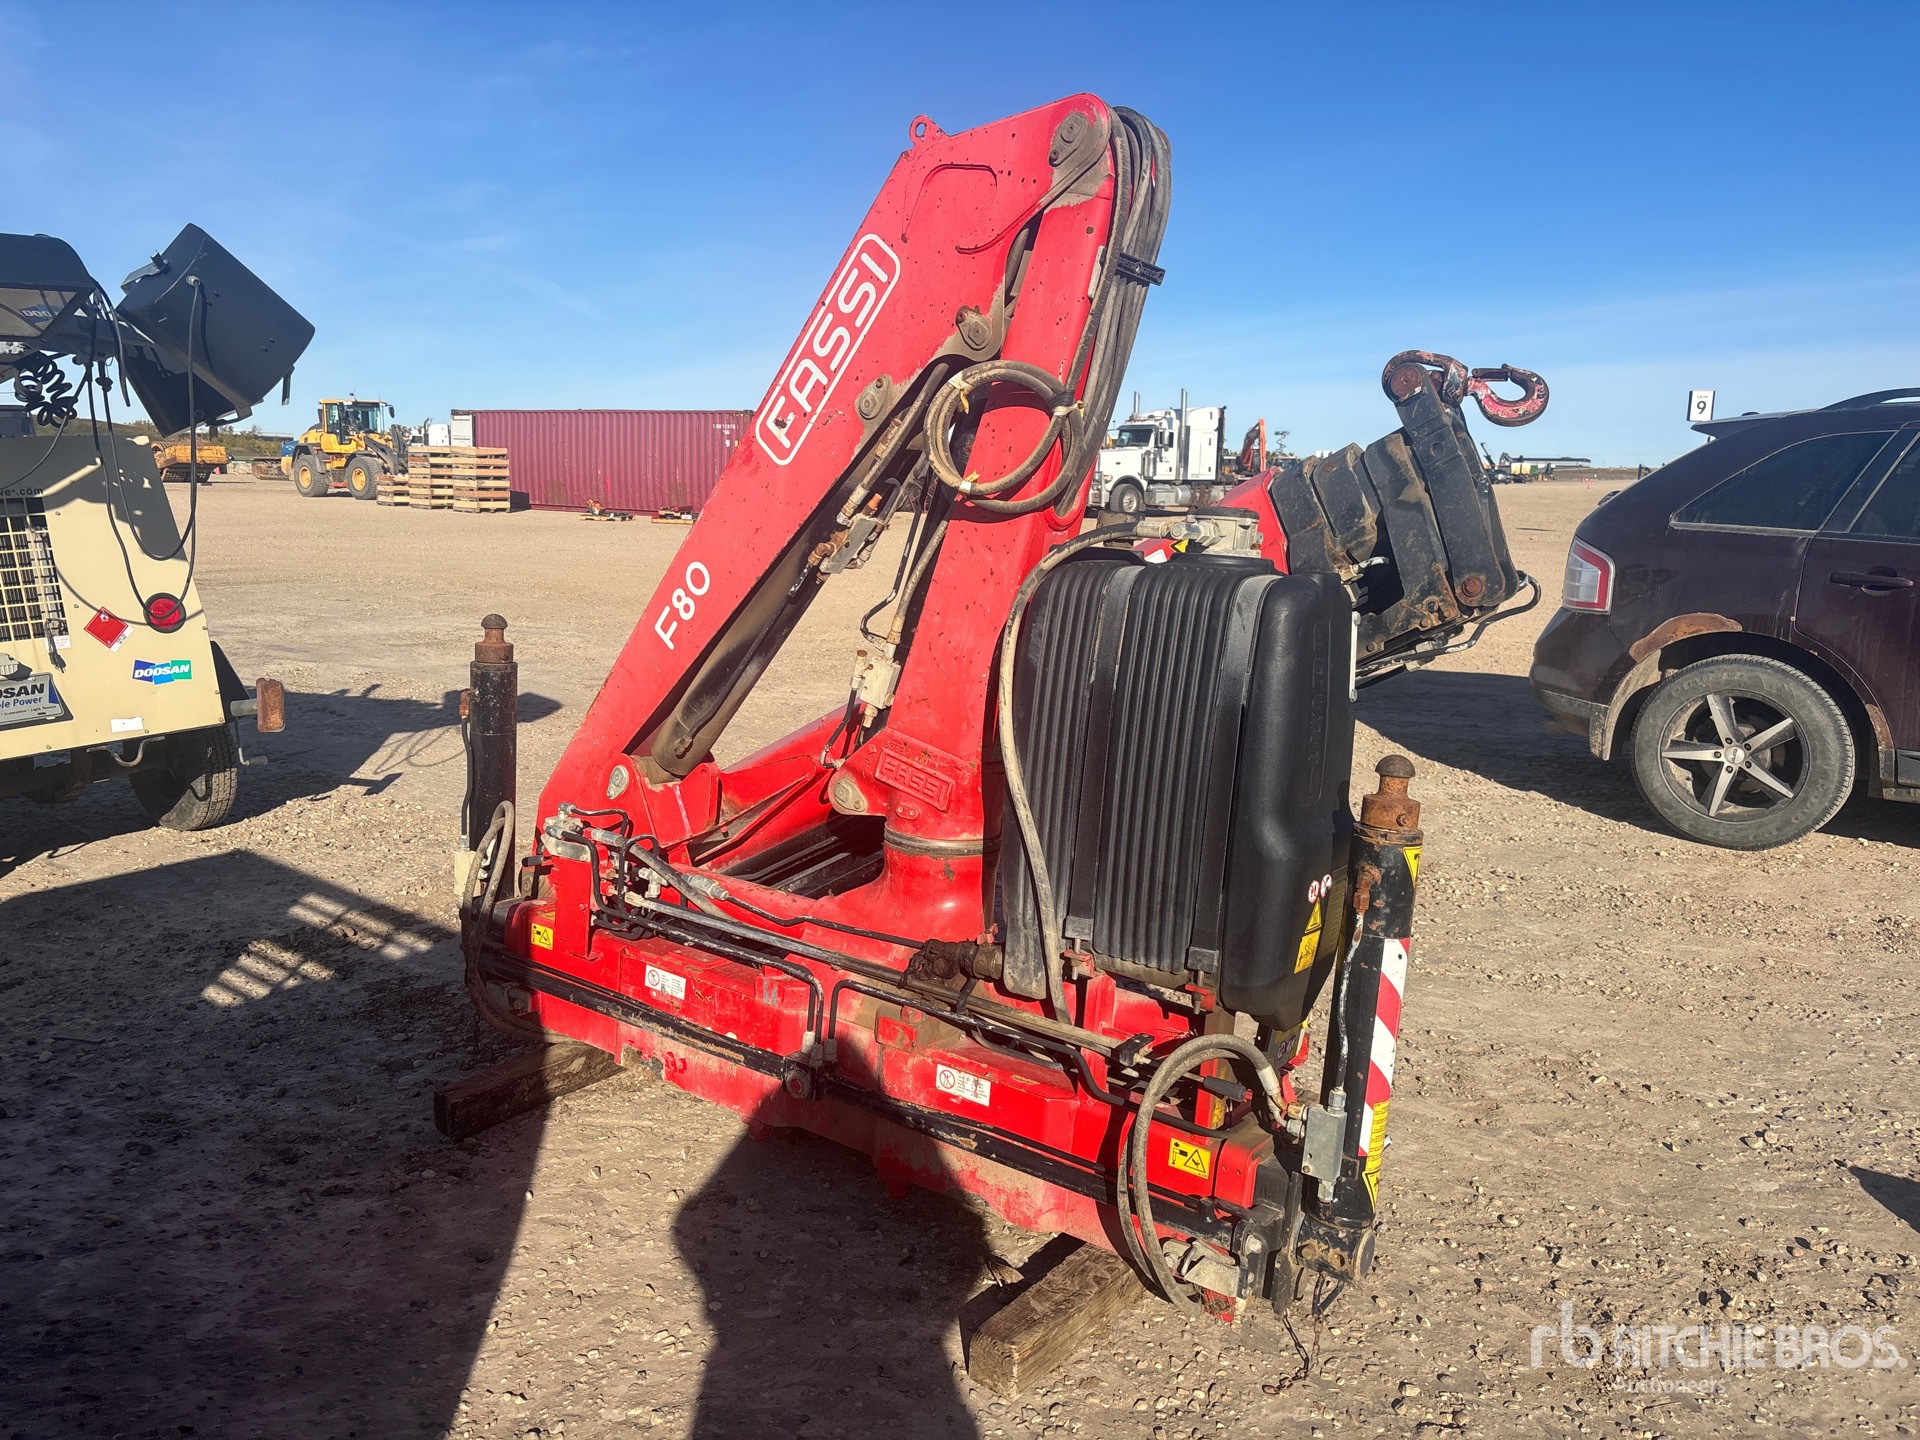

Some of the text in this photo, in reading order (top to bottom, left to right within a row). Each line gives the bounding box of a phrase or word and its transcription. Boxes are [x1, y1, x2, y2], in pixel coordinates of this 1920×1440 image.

[766, 251, 888, 449] FASSI
[1696, 400, 1707, 415] 9
[654, 561, 711, 650] F80
[134, 664, 190, 678] DOOSAN
[13, 696, 43, 707] Power
